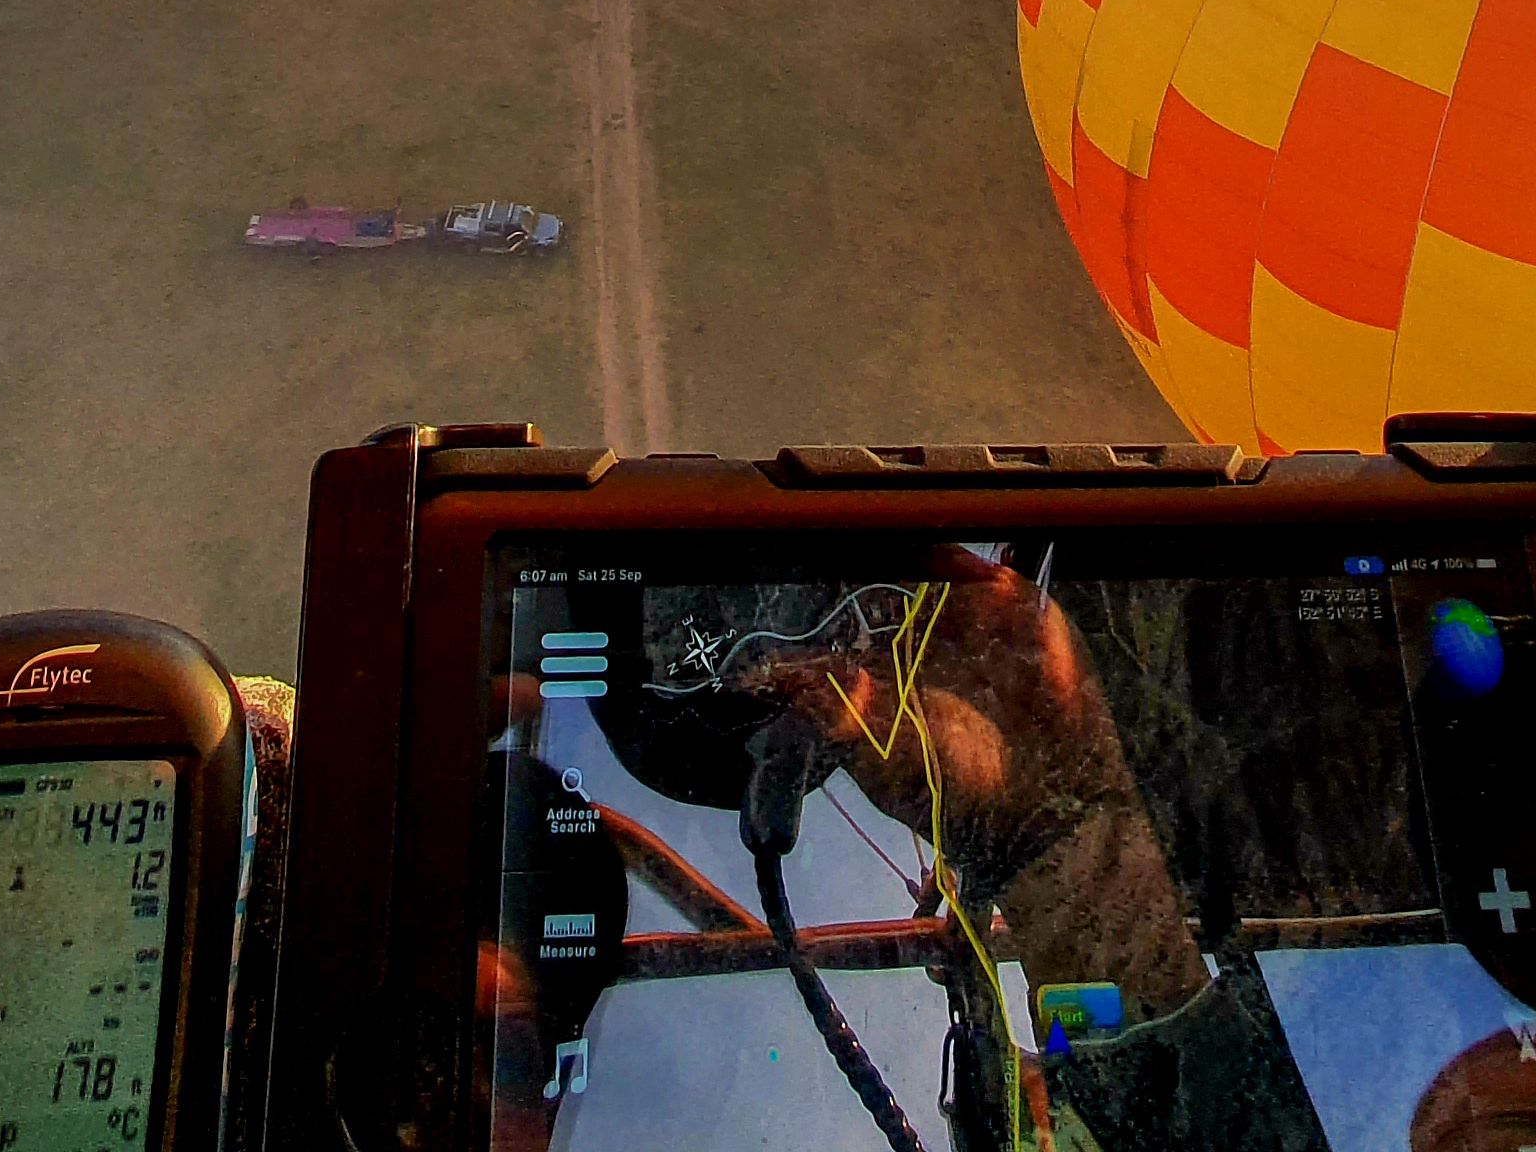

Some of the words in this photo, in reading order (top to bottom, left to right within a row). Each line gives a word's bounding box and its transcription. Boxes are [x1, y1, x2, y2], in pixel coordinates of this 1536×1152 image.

[519, 570, 547, 583] 6:07
[549, 571, 568, 582] am
[578, 569, 598, 582] Sat
[601, 569, 616, 581] 25
[619, 569, 642, 582] Sep
[30, 666, 92, 693] Flytec
[546, 807, 601, 821] Address
[72, 800, 149, 845] 443
[550, 821, 596, 834] Search
[539, 944, 596, 959] Measure
[52, 1055, 118, 1104] 178
